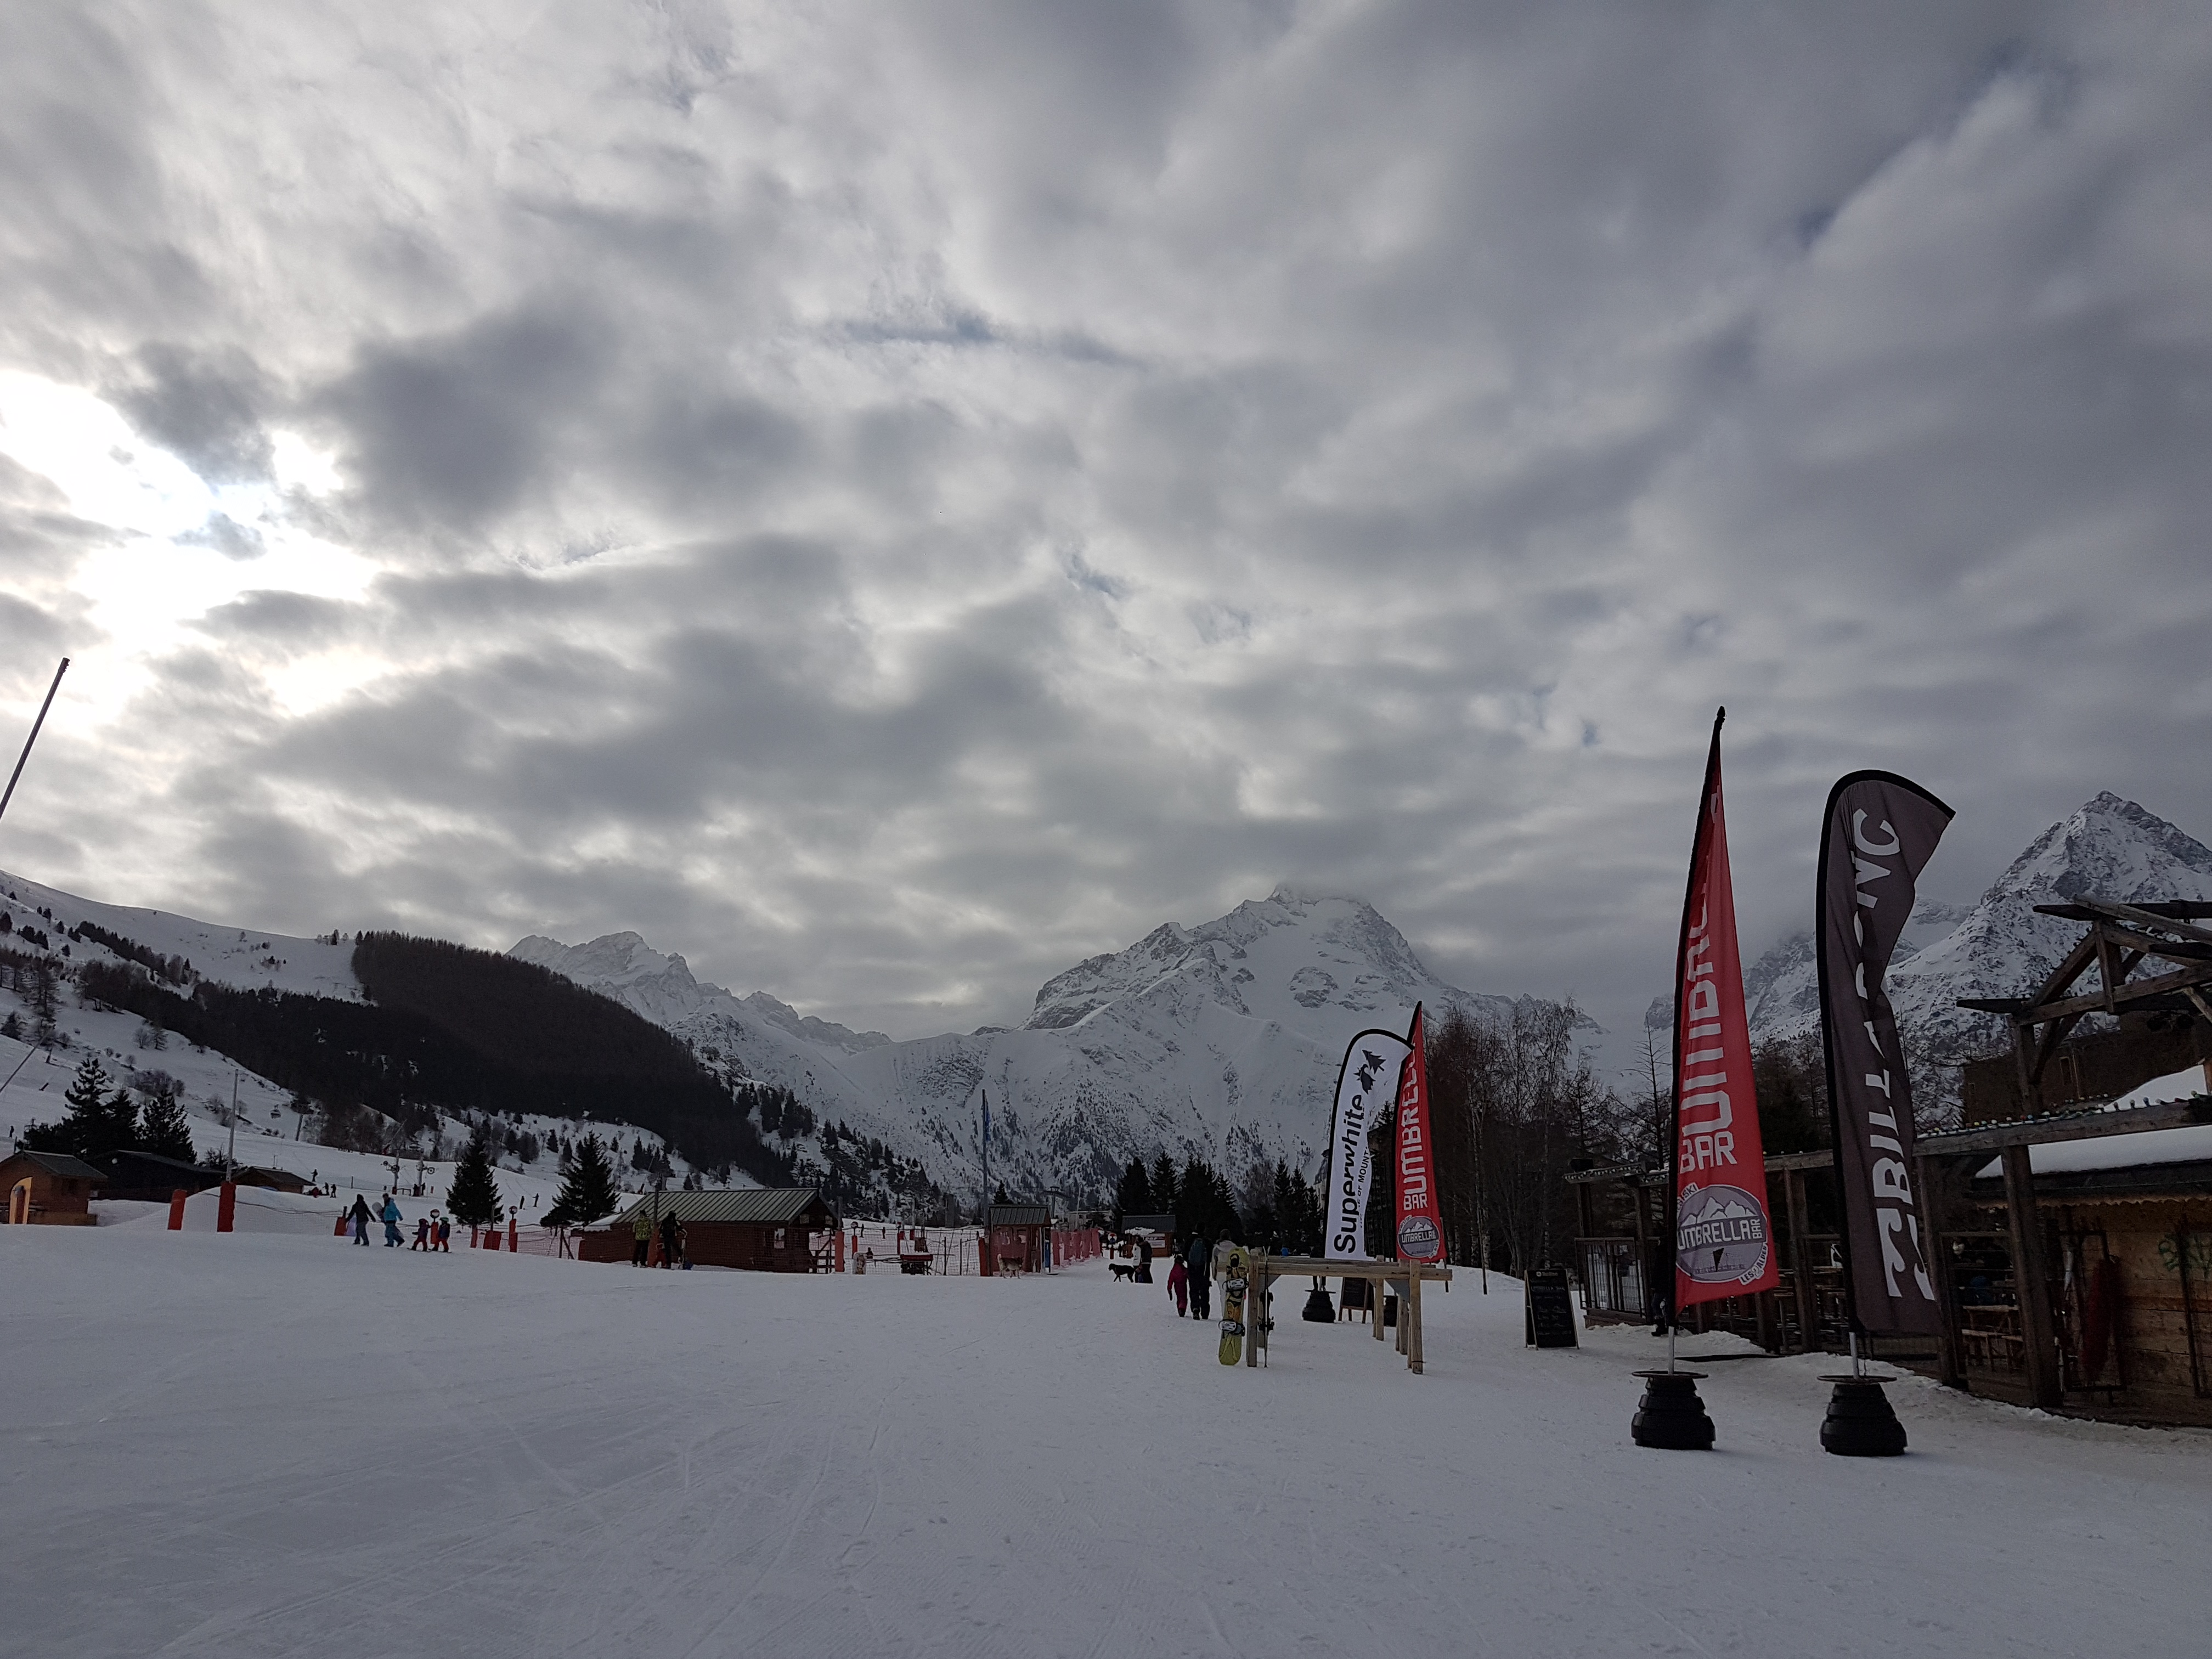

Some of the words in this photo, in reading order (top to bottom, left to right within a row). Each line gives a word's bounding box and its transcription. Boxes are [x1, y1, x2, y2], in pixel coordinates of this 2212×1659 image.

[1679, 1131, 1738, 1174] BAR
[1334, 1095, 1364, 1254] Superwhite
[1358, 1146, 1370, 1183] MOUNT
[1403, 1192, 1429, 1211] BAR
[1683, 1184, 1697, 1198] SKI
[1401, 1231, 1432, 1244] UMBRELLA
[1678, 1220, 1751, 1250] UMBRELLA
[1750, 1218, 1763, 1239] BAR
[1740, 1270, 1754, 1283] LES
